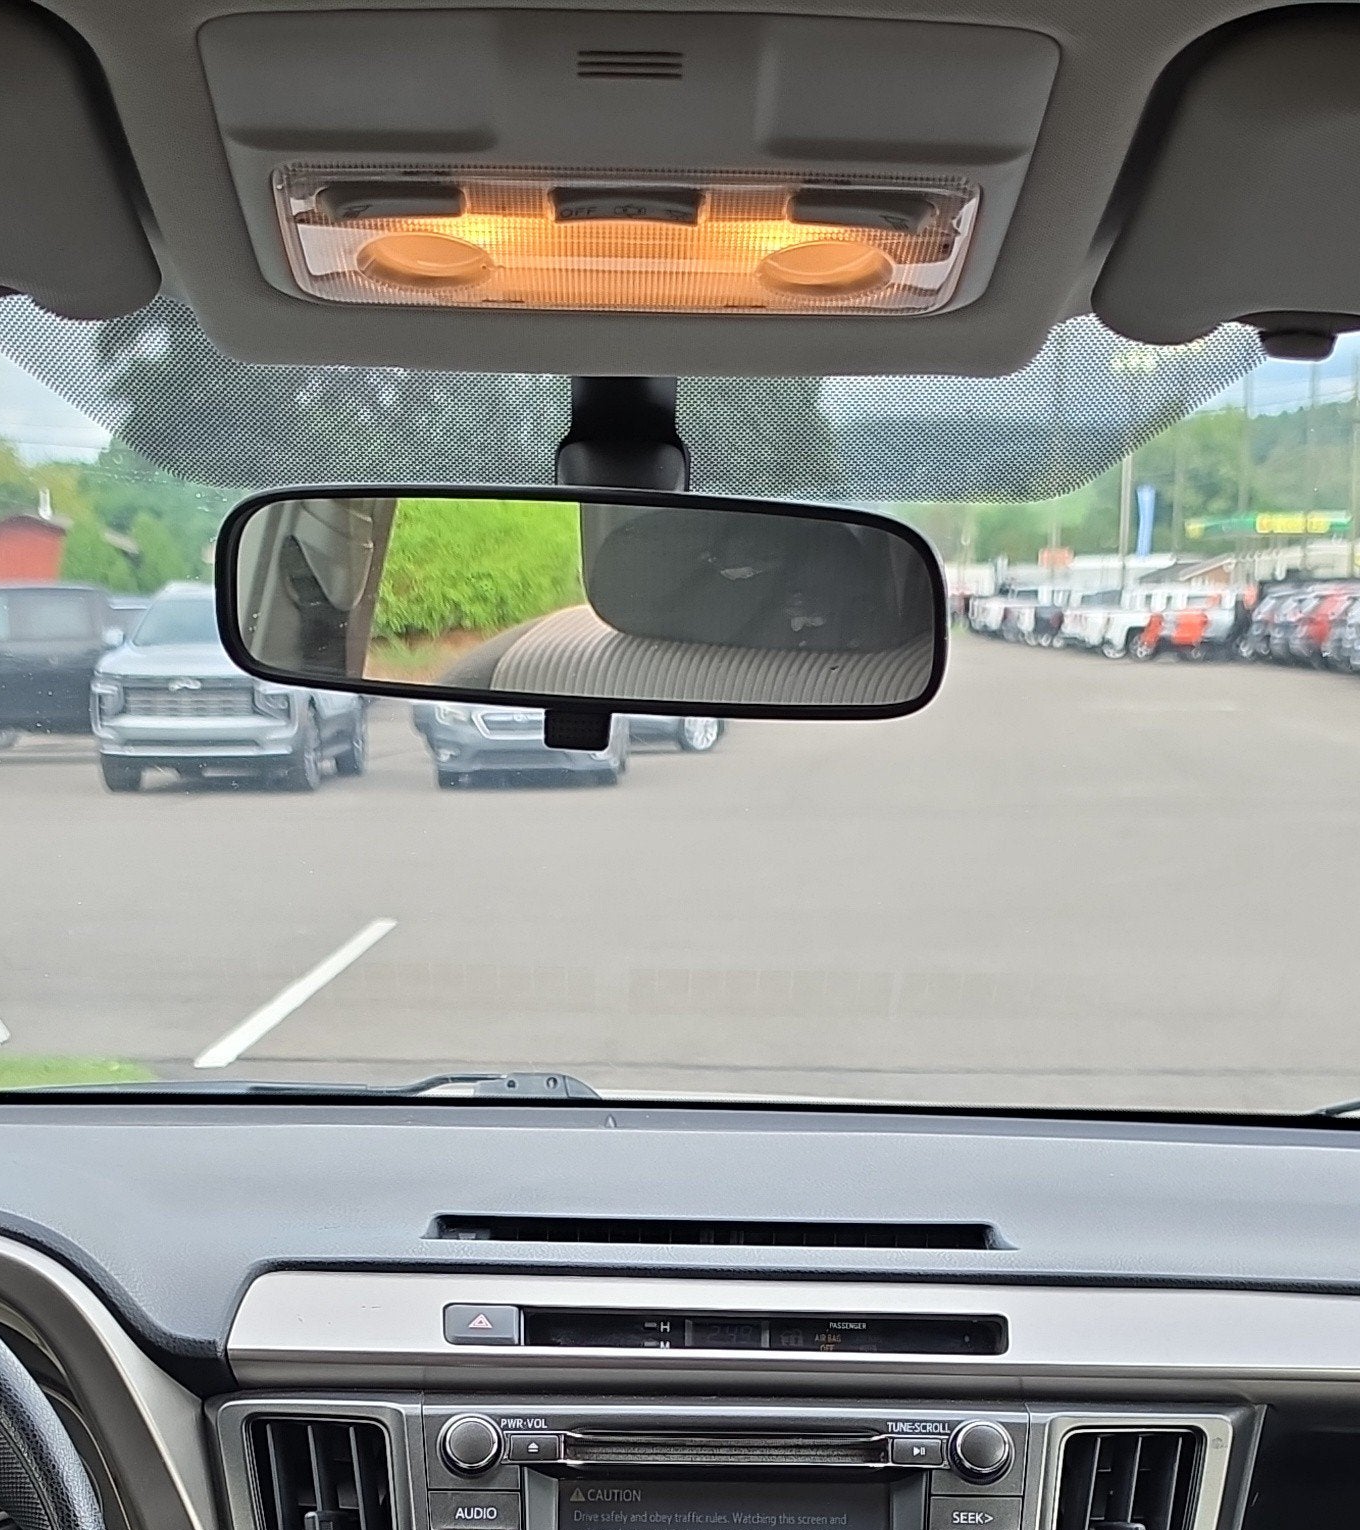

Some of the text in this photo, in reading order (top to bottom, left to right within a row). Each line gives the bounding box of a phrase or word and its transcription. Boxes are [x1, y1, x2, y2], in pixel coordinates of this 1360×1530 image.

[560, 206, 597, 218] OFF
[660, 1321, 671, 1333] H
[829, 1322, 867, 1331] PASSENGER
[587, 1489, 642, 1502] CAUTION
[455, 1507, 498, 1520] AUDIO
[573, 1510, 599, 1523] Drive
[601, 1510, 628, 1524] safely
[630, 1511, 648, 1523] and
[649, 1512, 672, 1525] obey
[675, 1511, 704, 1524] traffic
[732, 1512, 777, 1526] Watching
[779, 1513, 796, 1525] this
[797, 1515, 828, 1525] screen
[829, 1514, 848, 1526] and
